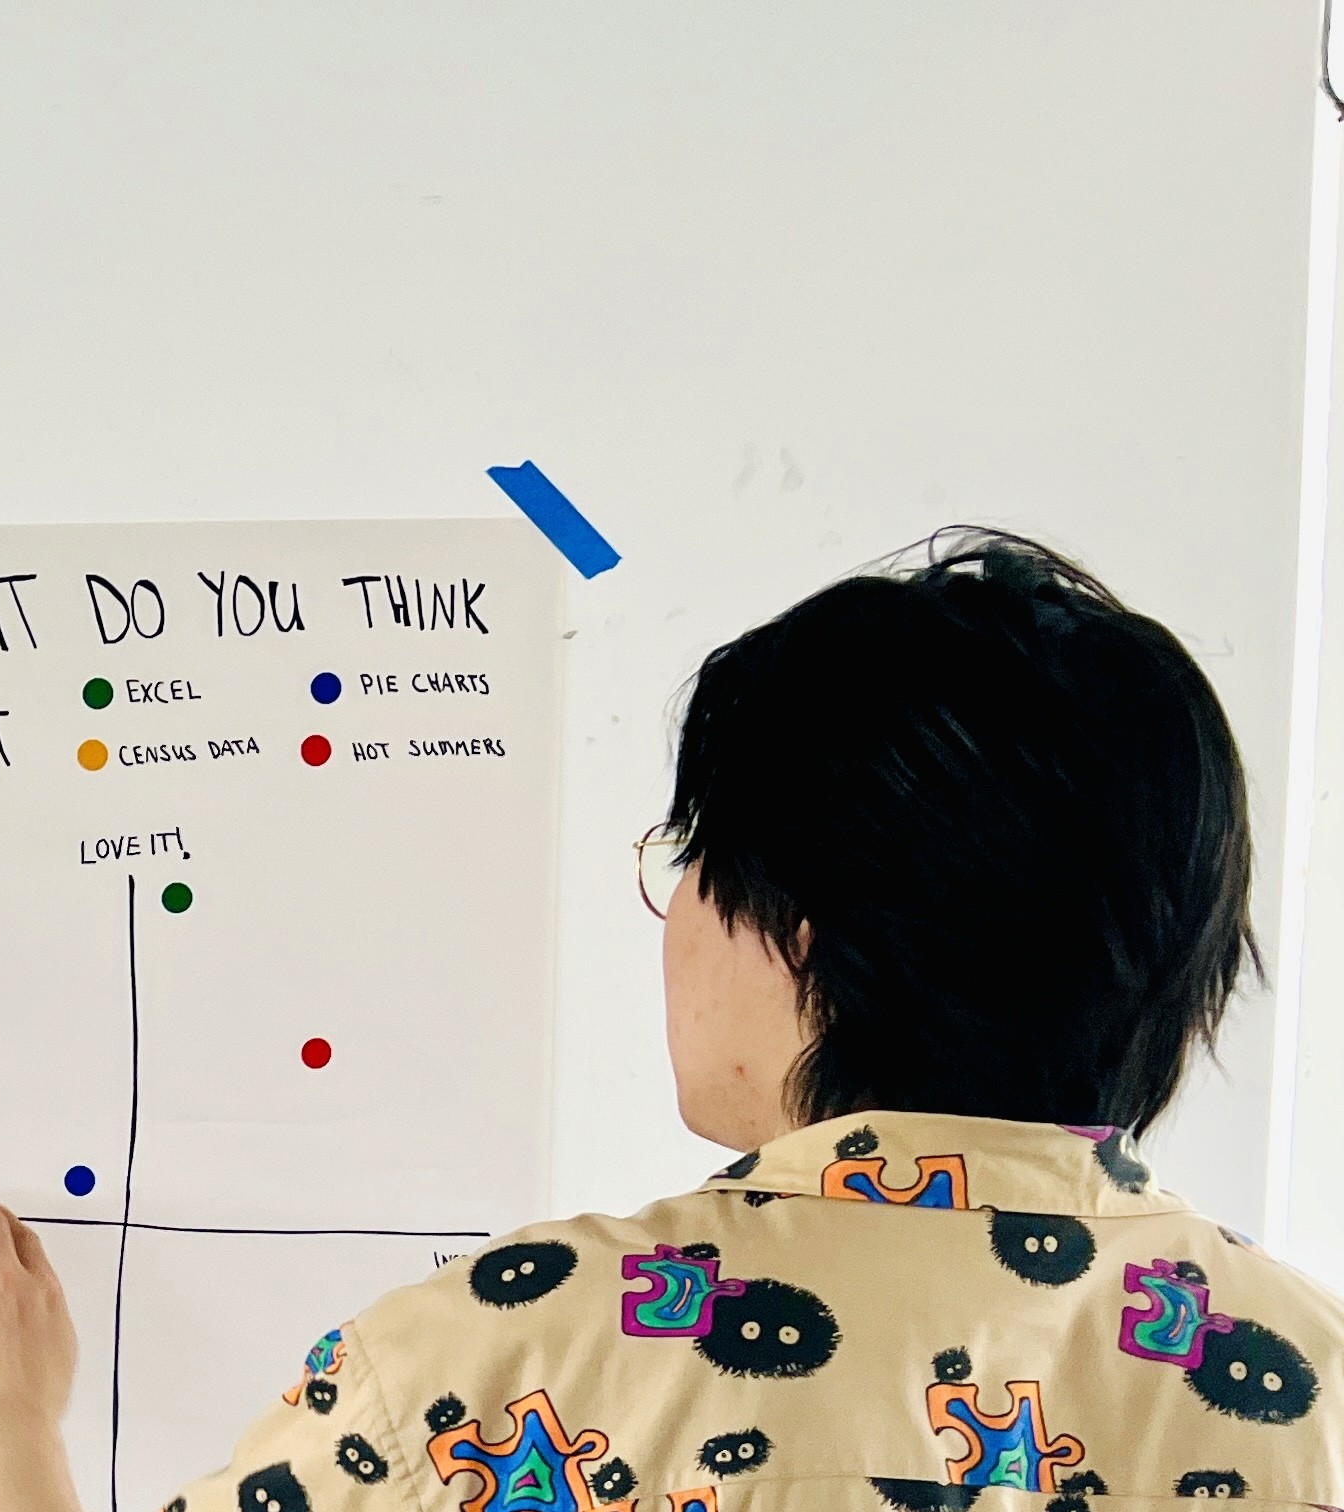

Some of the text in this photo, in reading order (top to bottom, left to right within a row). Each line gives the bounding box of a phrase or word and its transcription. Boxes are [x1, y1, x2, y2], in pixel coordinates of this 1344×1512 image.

[85, 573, 166, 645] DO
[197, 570, 306, 638] YOU
[340, 574, 491, 635] THINK
[125, 678, 202, 705] EXCEL
[359, 671, 490, 696] PIE CHARTS
[118, 736, 261, 767] CENSUS DATA
[351, 737, 506, 763] HOT SUMMERS
[80, 826, 191, 865] LOVE IT!
